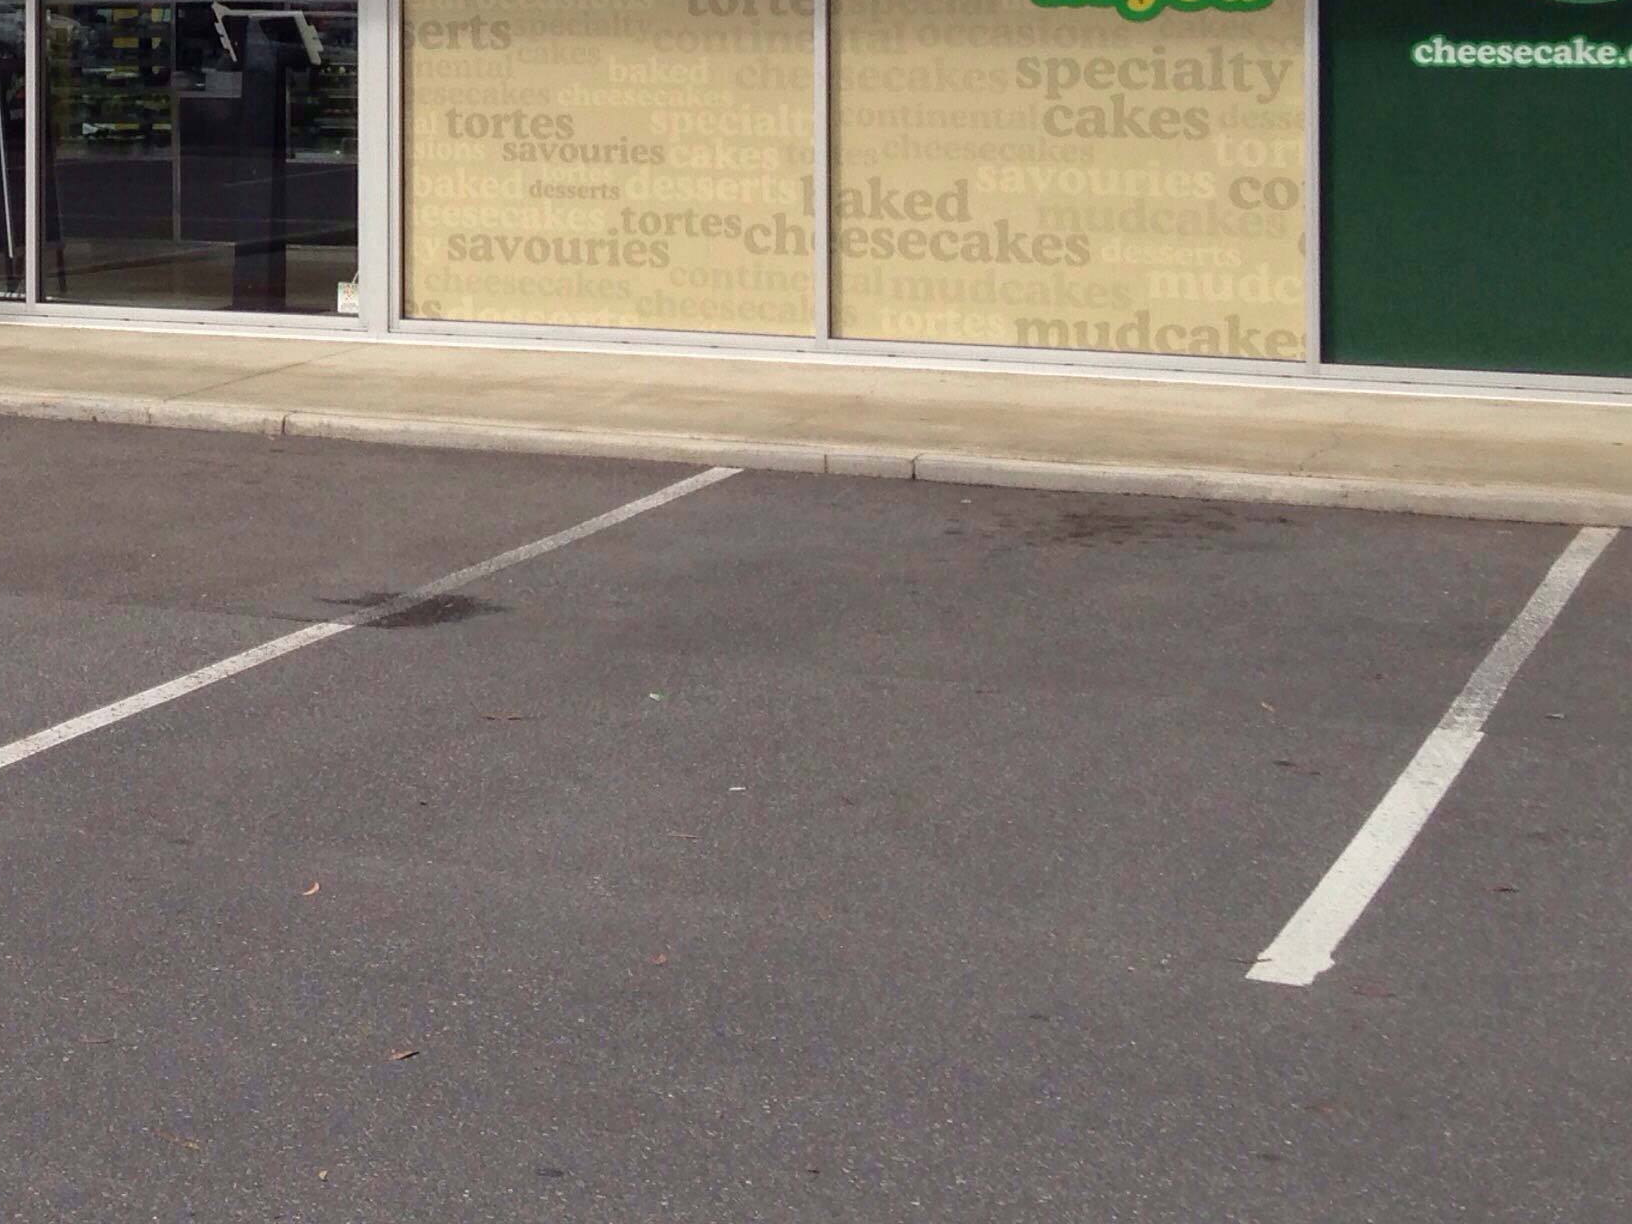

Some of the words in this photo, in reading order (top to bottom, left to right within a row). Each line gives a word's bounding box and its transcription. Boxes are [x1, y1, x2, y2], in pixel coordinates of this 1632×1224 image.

[1413, 37, 1632, 65] cheesecake.
[1016, 45, 1294, 105] specialty
[445, 107, 576, 141] tortes
[1043, 94, 1211, 141] cakes
[502, 136, 667, 166] savouries
[528, 178, 621, 201] desserts
[619, 206, 742, 239] tortes
[447, 227, 672, 269] savouries
[1013, 310, 1306, 361] mudcake
